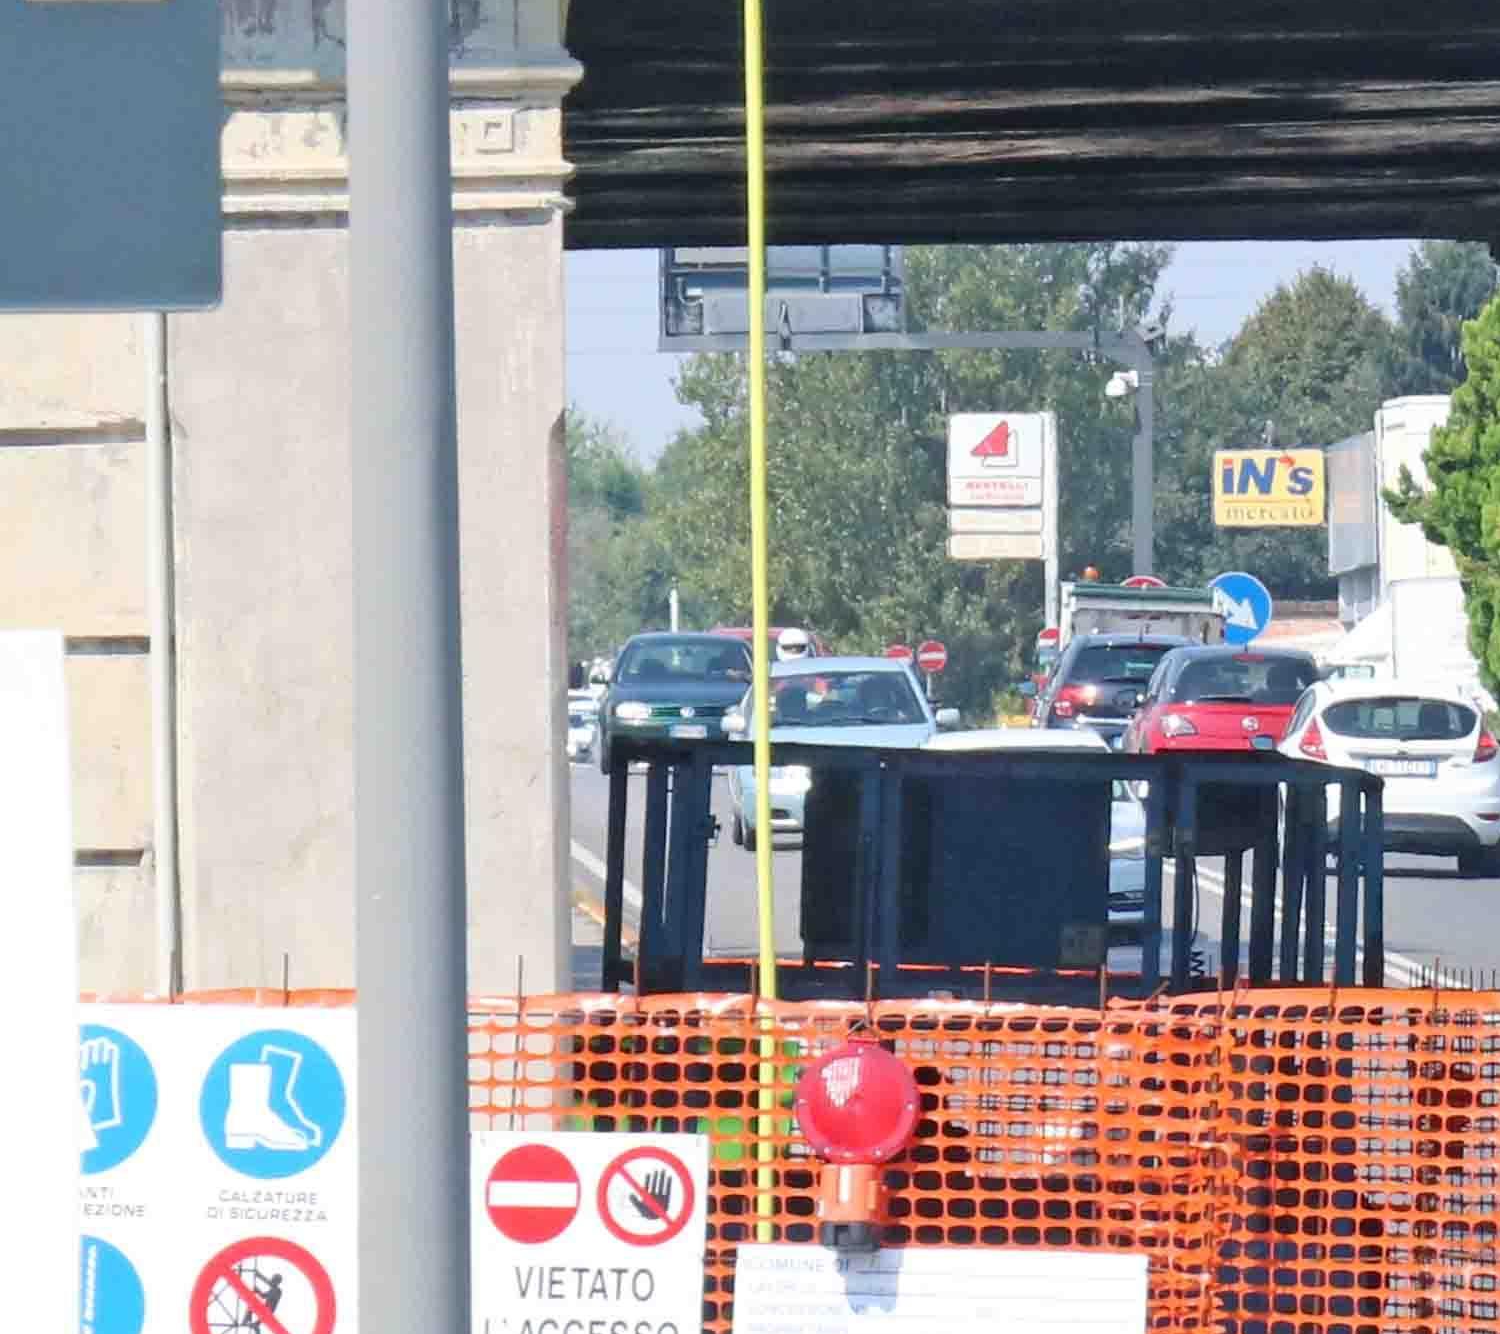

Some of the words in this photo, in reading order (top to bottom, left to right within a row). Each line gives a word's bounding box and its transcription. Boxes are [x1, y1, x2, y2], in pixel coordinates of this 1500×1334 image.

[218, 1189, 319, 1206] CALZATURE
[206, 1207, 222, 1220] DI
[229, 1207, 328, 1223] SICUREZZA
[514, 1266, 655, 1302] VIETATO
